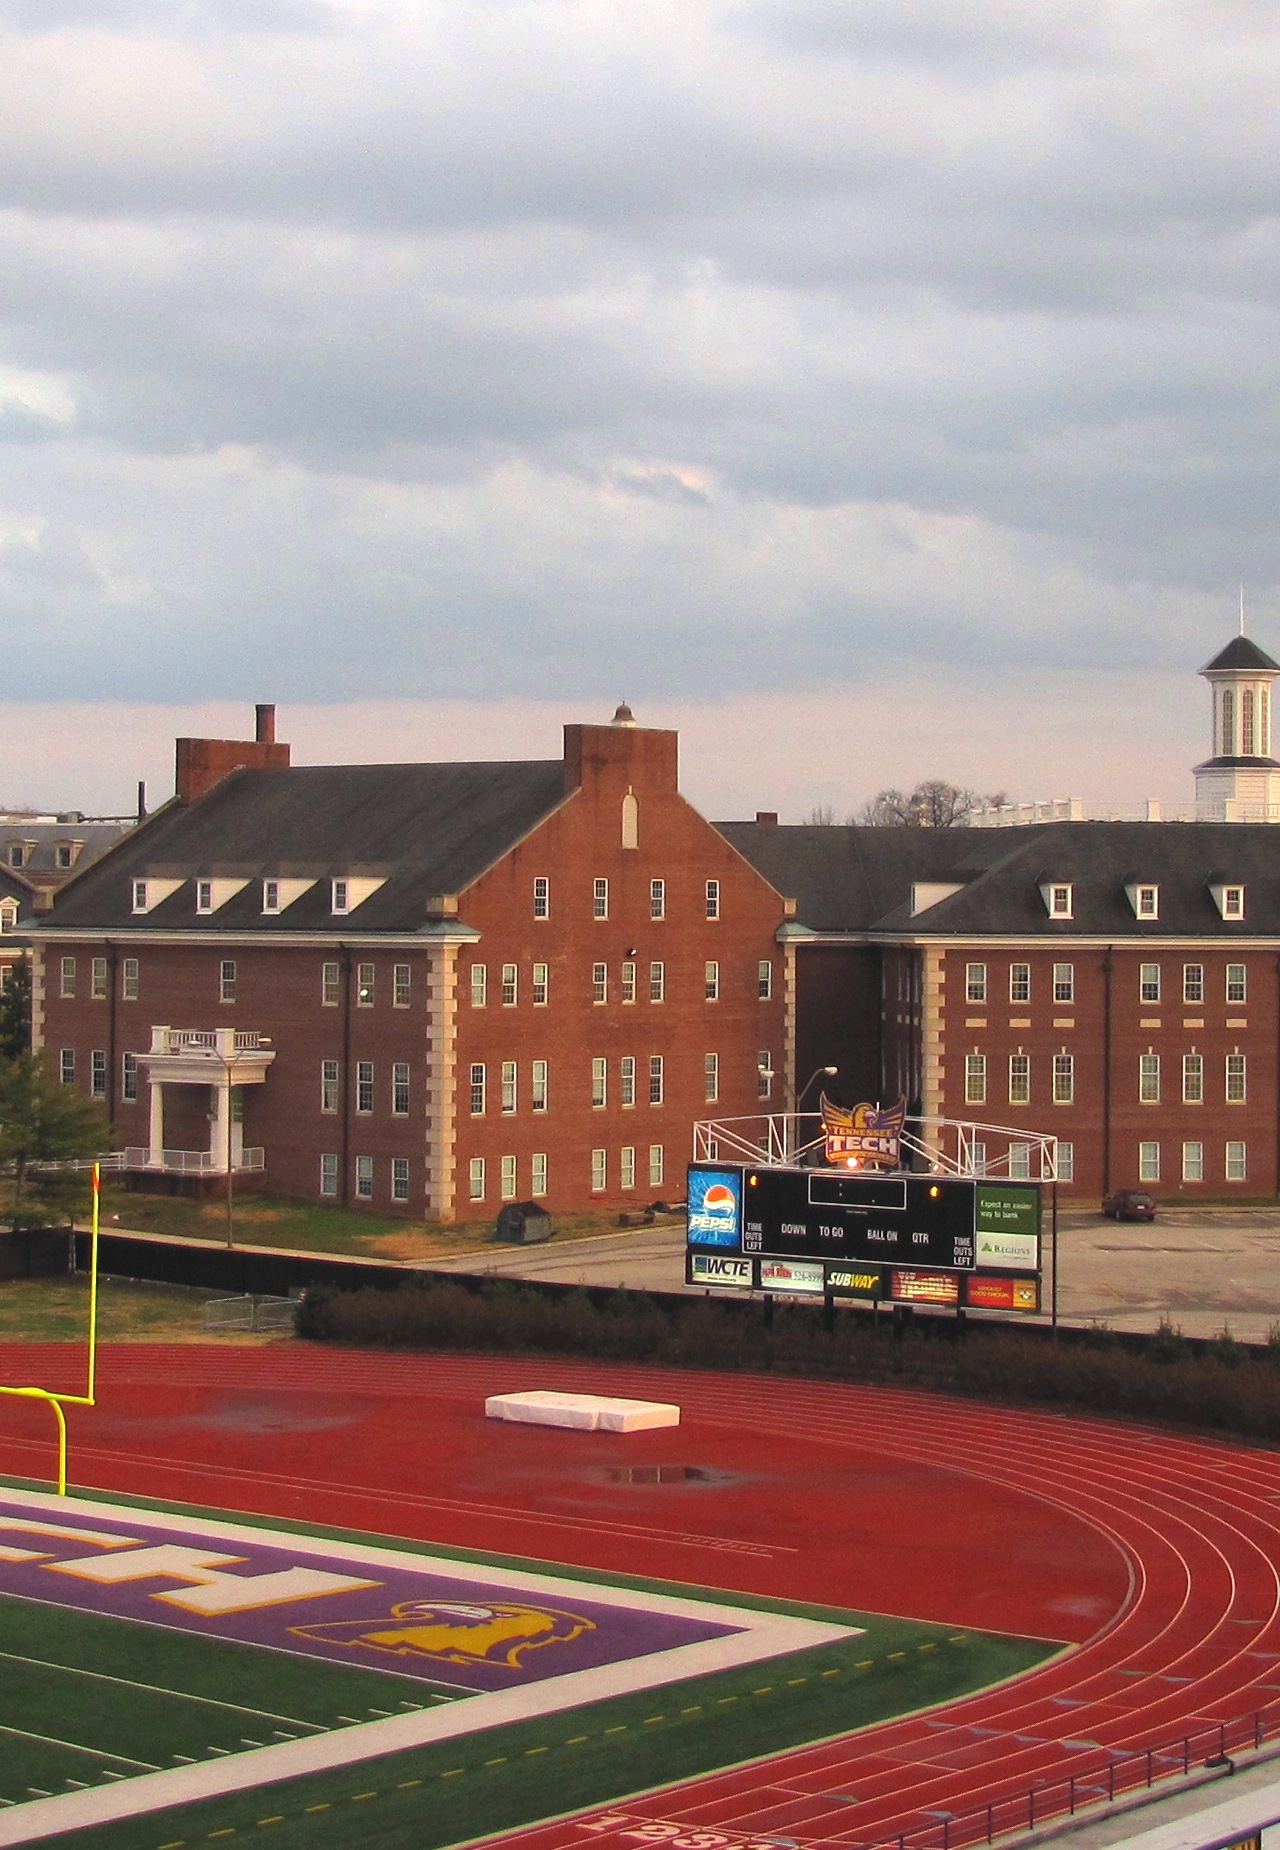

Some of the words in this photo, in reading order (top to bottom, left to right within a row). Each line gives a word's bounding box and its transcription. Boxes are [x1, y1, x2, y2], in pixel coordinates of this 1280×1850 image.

[833, 1126, 893, 1137] TENNESSEE
[828, 1135, 898, 1156] TECH
[689, 1214, 736, 1232] PEPSI
[747, 1222, 763, 1231] TIME
[781, 1223, 807, 1236] DOWN
[745, 1232, 763, 1241] OUTS
[819, 1225, 830, 1237] TO
[831, 1226, 844, 1238] GO
[867, 1229, 885, 1241] BALL
[886, 1230, 898, 1242] ON
[912, 1232, 929, 1244] QTR
[746, 1241, 762, 1250] LEFT
[953, 1236, 971, 1246] TIME
[953, 1246, 972, 1256] OUTS
[707, 1258, 749, 1277] WCTE
[953, 1257, 970, 1266] LEFT
[827, 1271, 880, 1289] SUBWAY
[576, 1815, 630, 1832] 1
[620, 1824, 681, 1841] 2
[672, 1833, 728, 1849] 3
